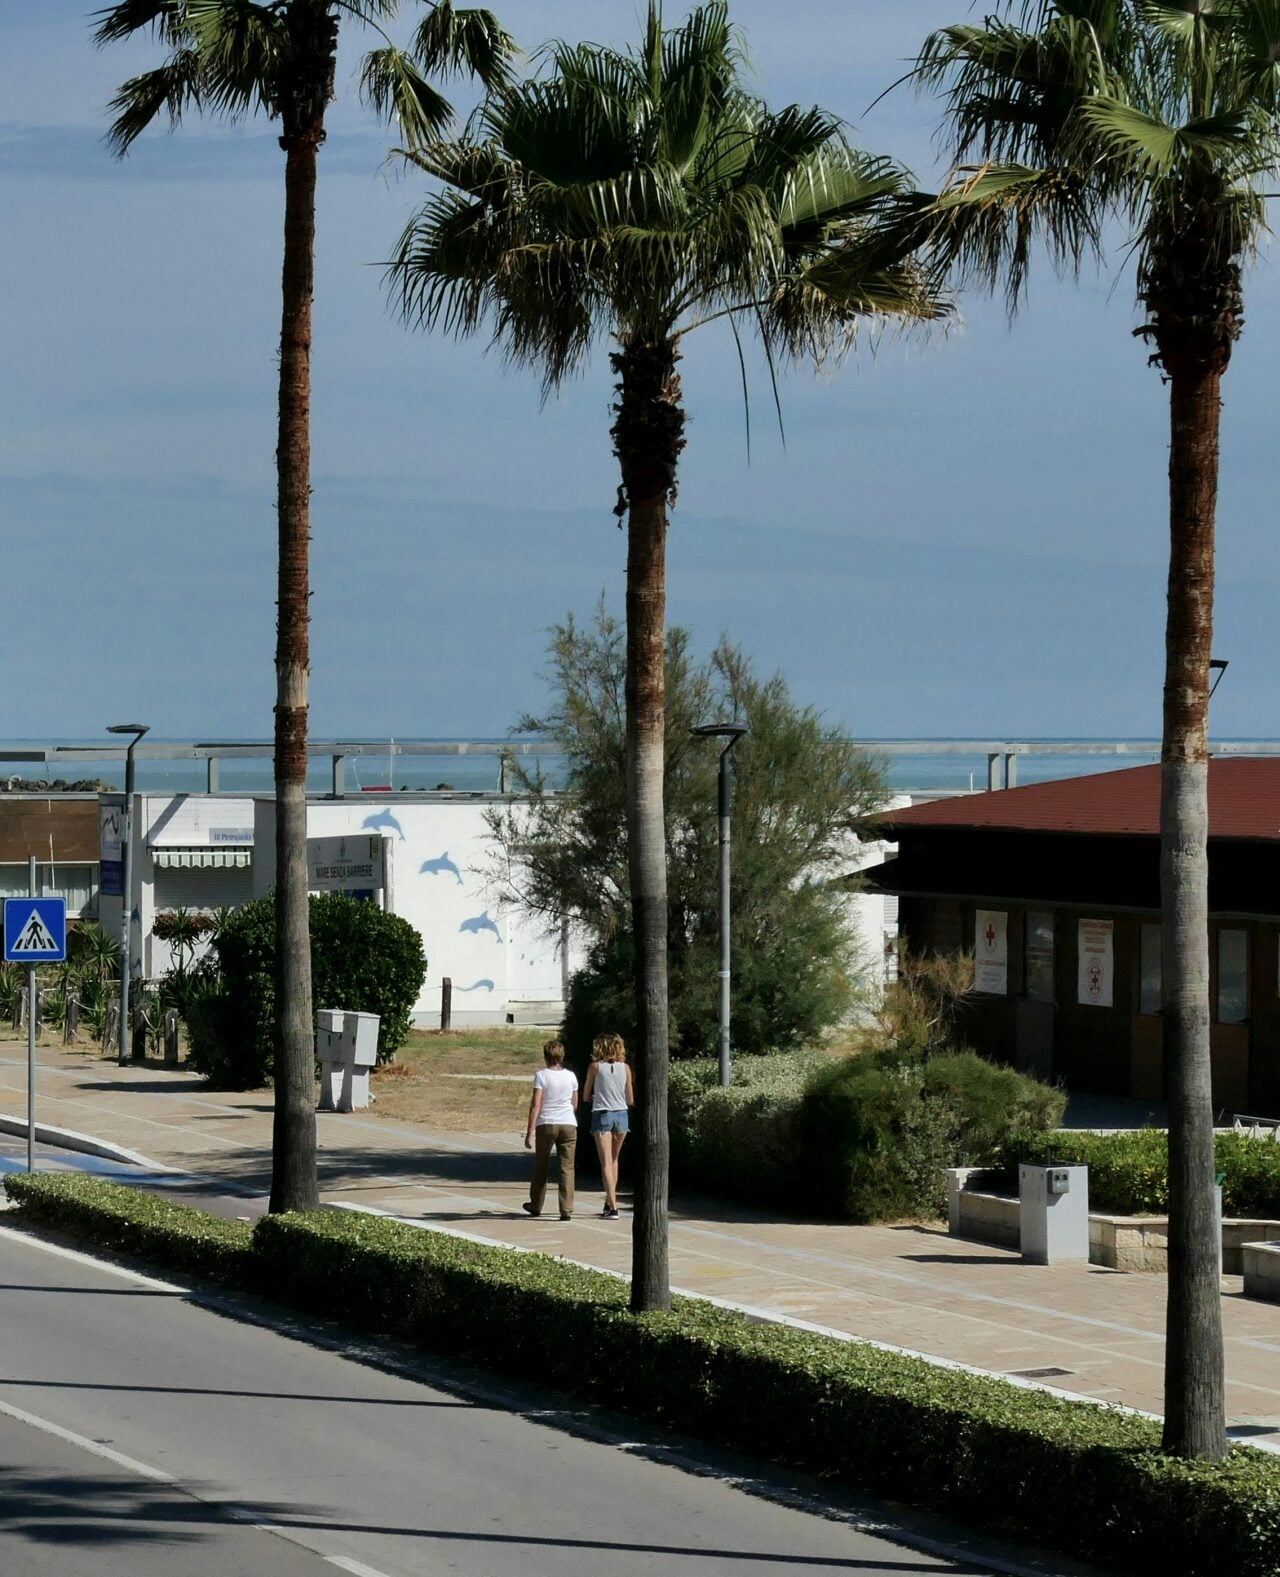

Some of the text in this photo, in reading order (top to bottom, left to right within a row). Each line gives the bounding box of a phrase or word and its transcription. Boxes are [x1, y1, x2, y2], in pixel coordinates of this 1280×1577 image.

[315, 864, 373, 879] MARE SENZA BARRIERE
